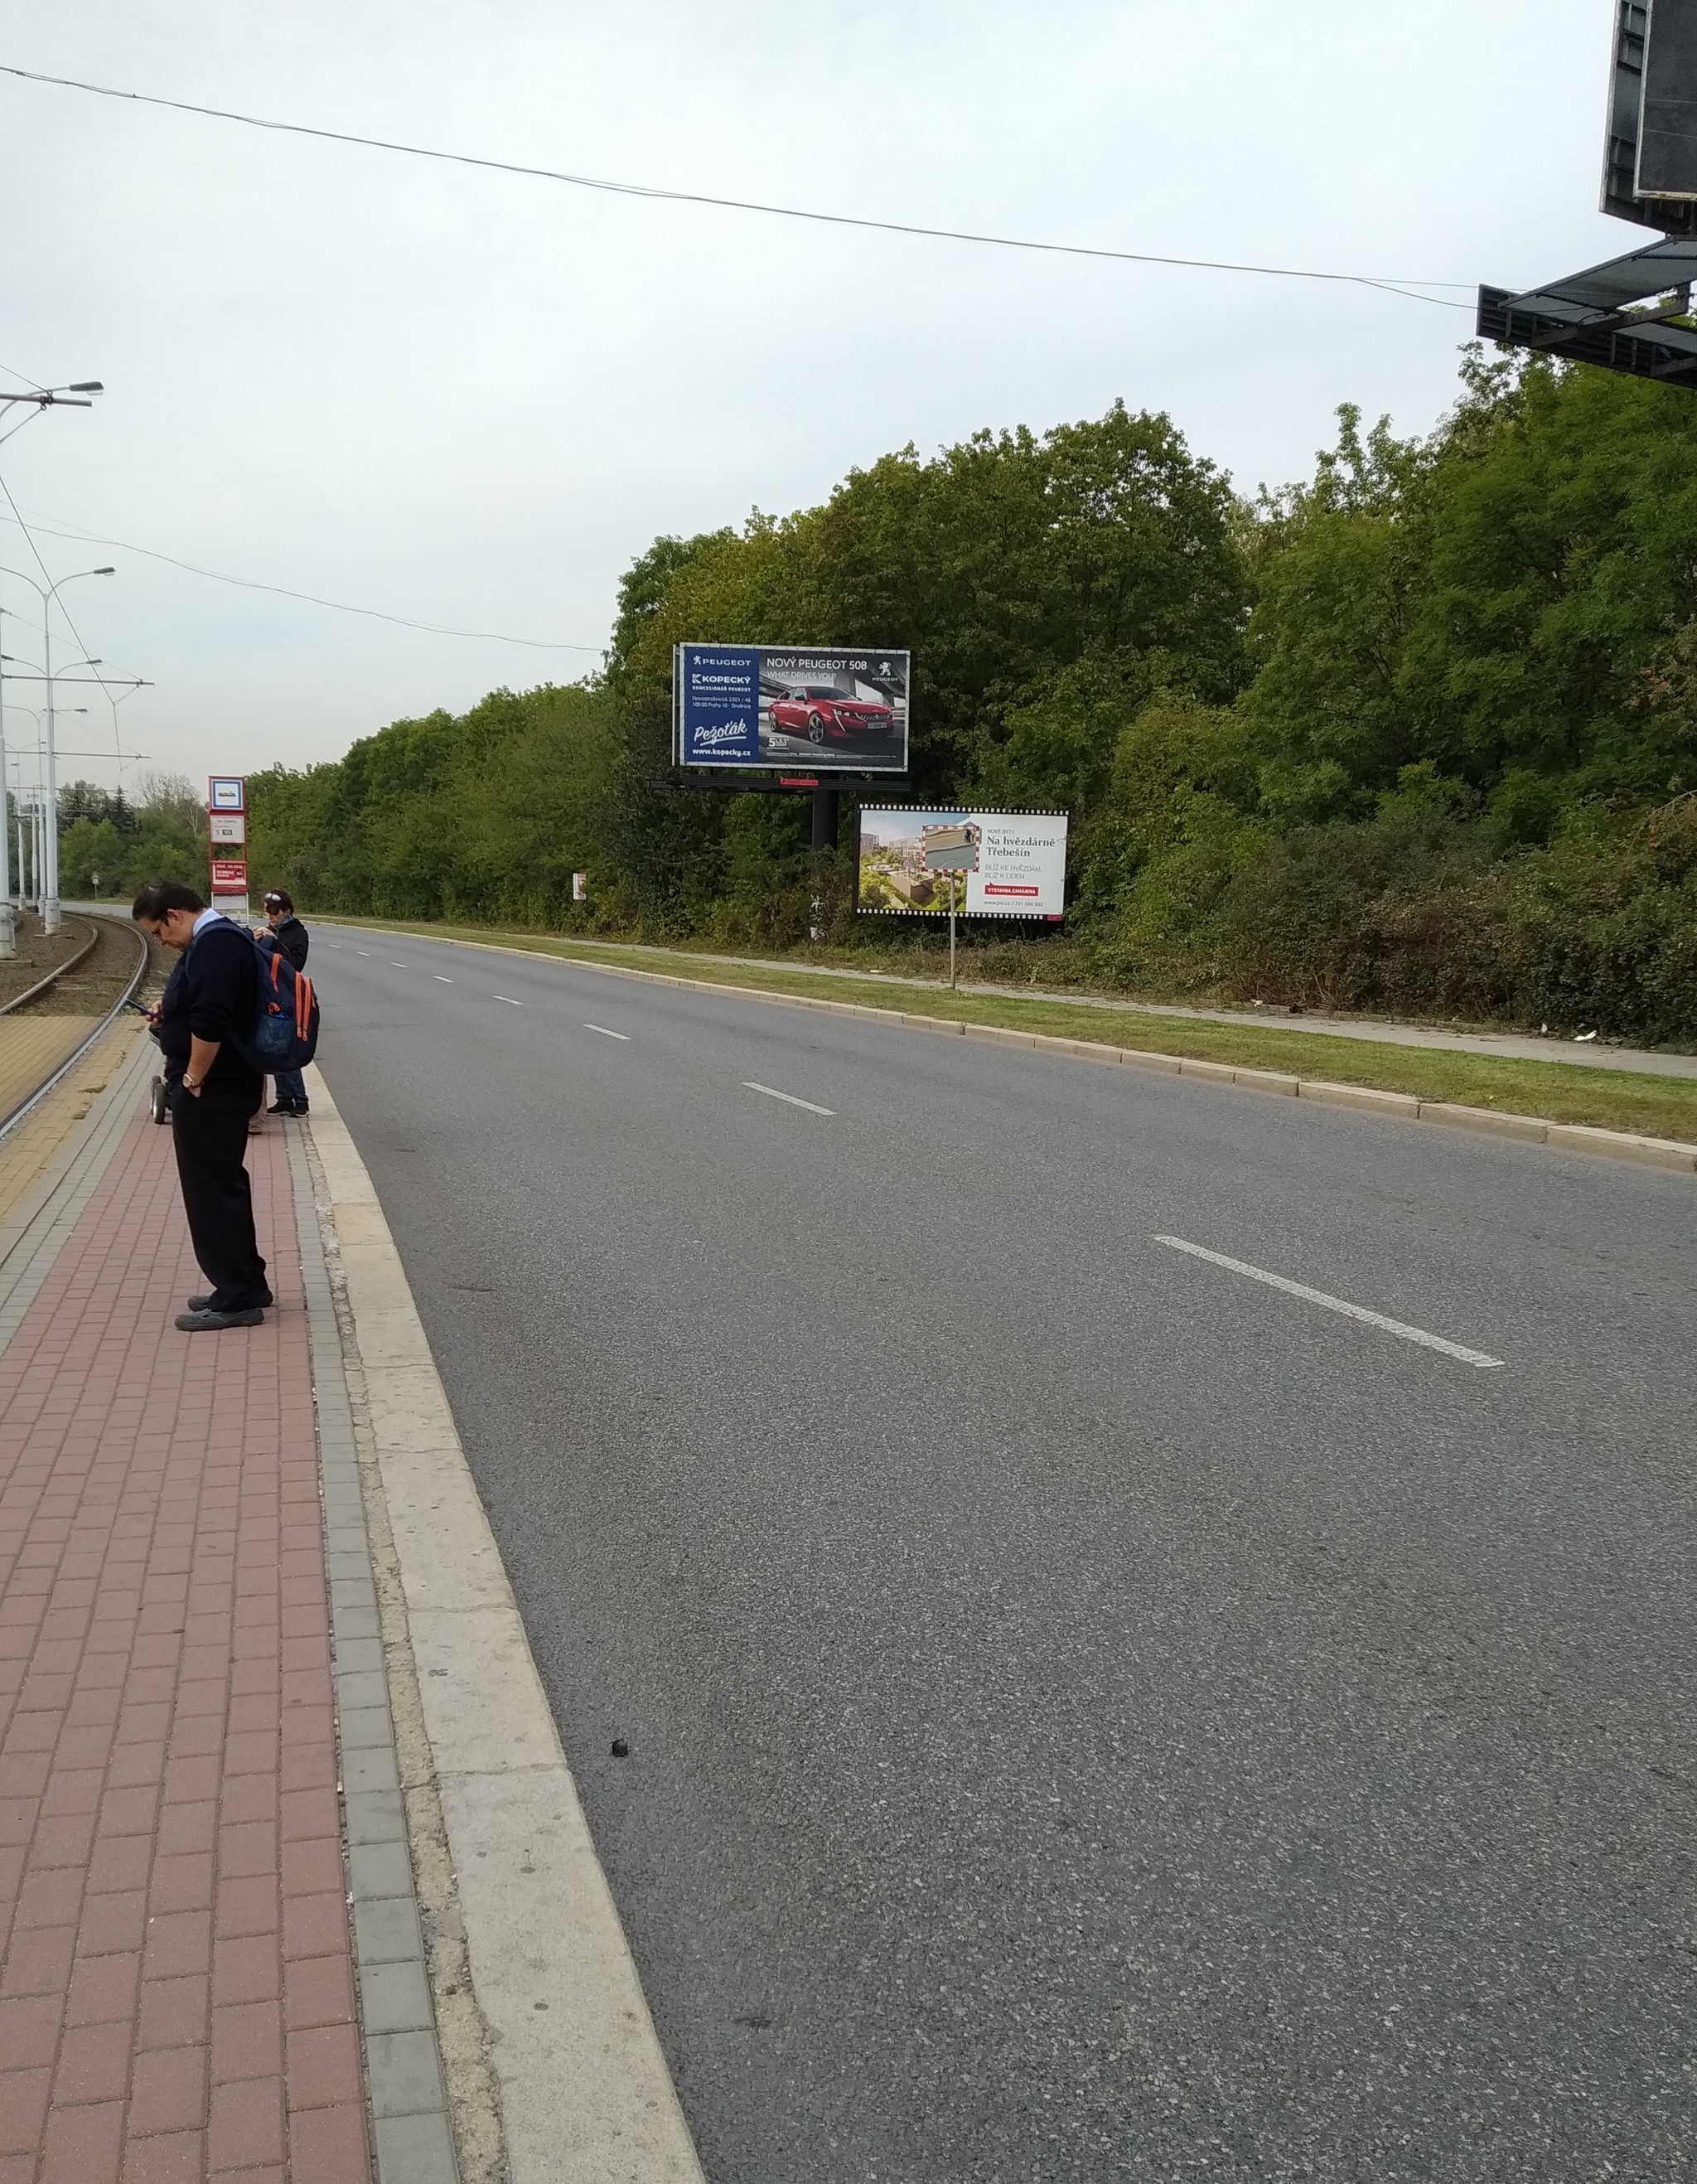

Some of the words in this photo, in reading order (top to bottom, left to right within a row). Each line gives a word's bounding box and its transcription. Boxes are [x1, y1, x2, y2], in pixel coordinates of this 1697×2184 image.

[703, 658, 752, 666] PEUGEOT
[766, 656, 797, 667] NOVÝ
[799, 659, 847, 670] PEUGEOT
[849, 661, 868, 671] 508
[702, 675, 752, 685] KOPECKÝ
[694, 718, 748, 745] Pežoťák
[692, 748, 752, 758] www.kopecky.cz
[987, 835, 1000, 845] Na
[1003, 836, 1056, 847] hvězdárně
[986, 846, 1031, 857] Třebešín
